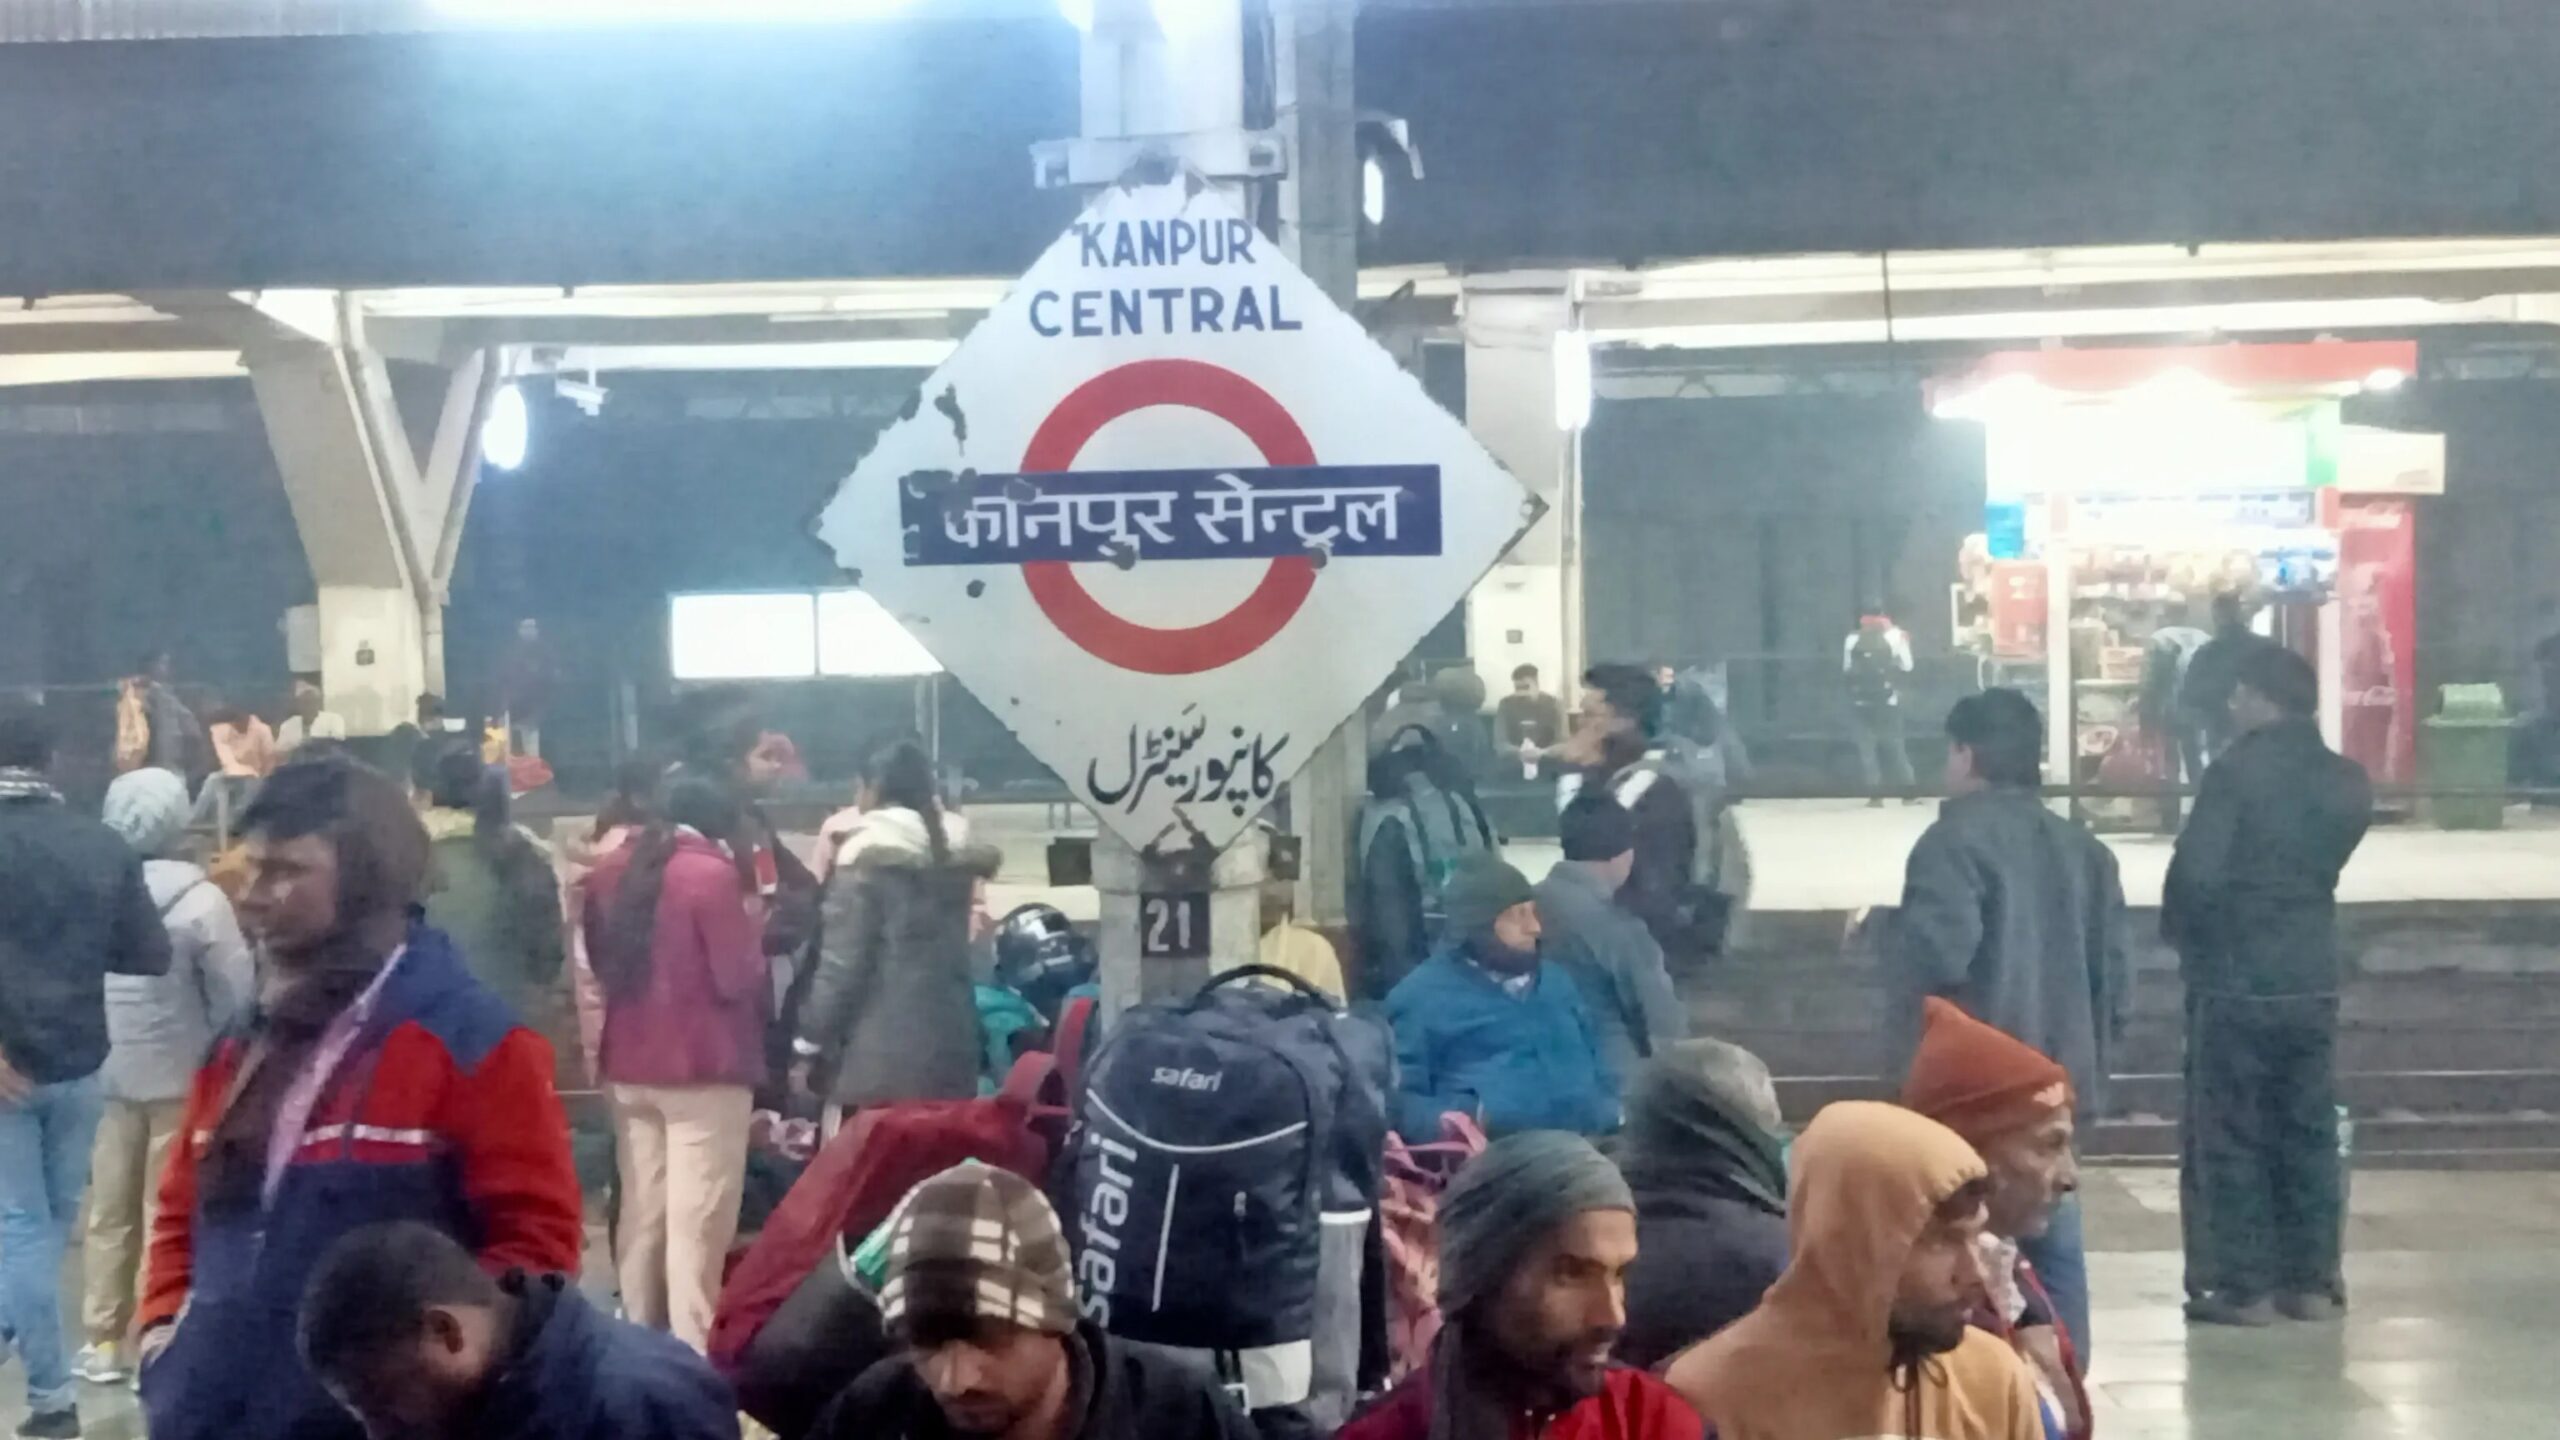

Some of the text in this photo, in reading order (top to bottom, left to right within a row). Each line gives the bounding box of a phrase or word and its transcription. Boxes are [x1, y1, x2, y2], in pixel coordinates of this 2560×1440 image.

[1078, 218, 1258, 268] KANPUR
[1029, 284, 1304, 338] CENTRAL
[944, 490, 1180, 562] कानपुर
[1144, 897, 1193, 953] 21
[1150, 1066, 1223, 1093] safari
[1075, 1131, 1139, 1330] safari
